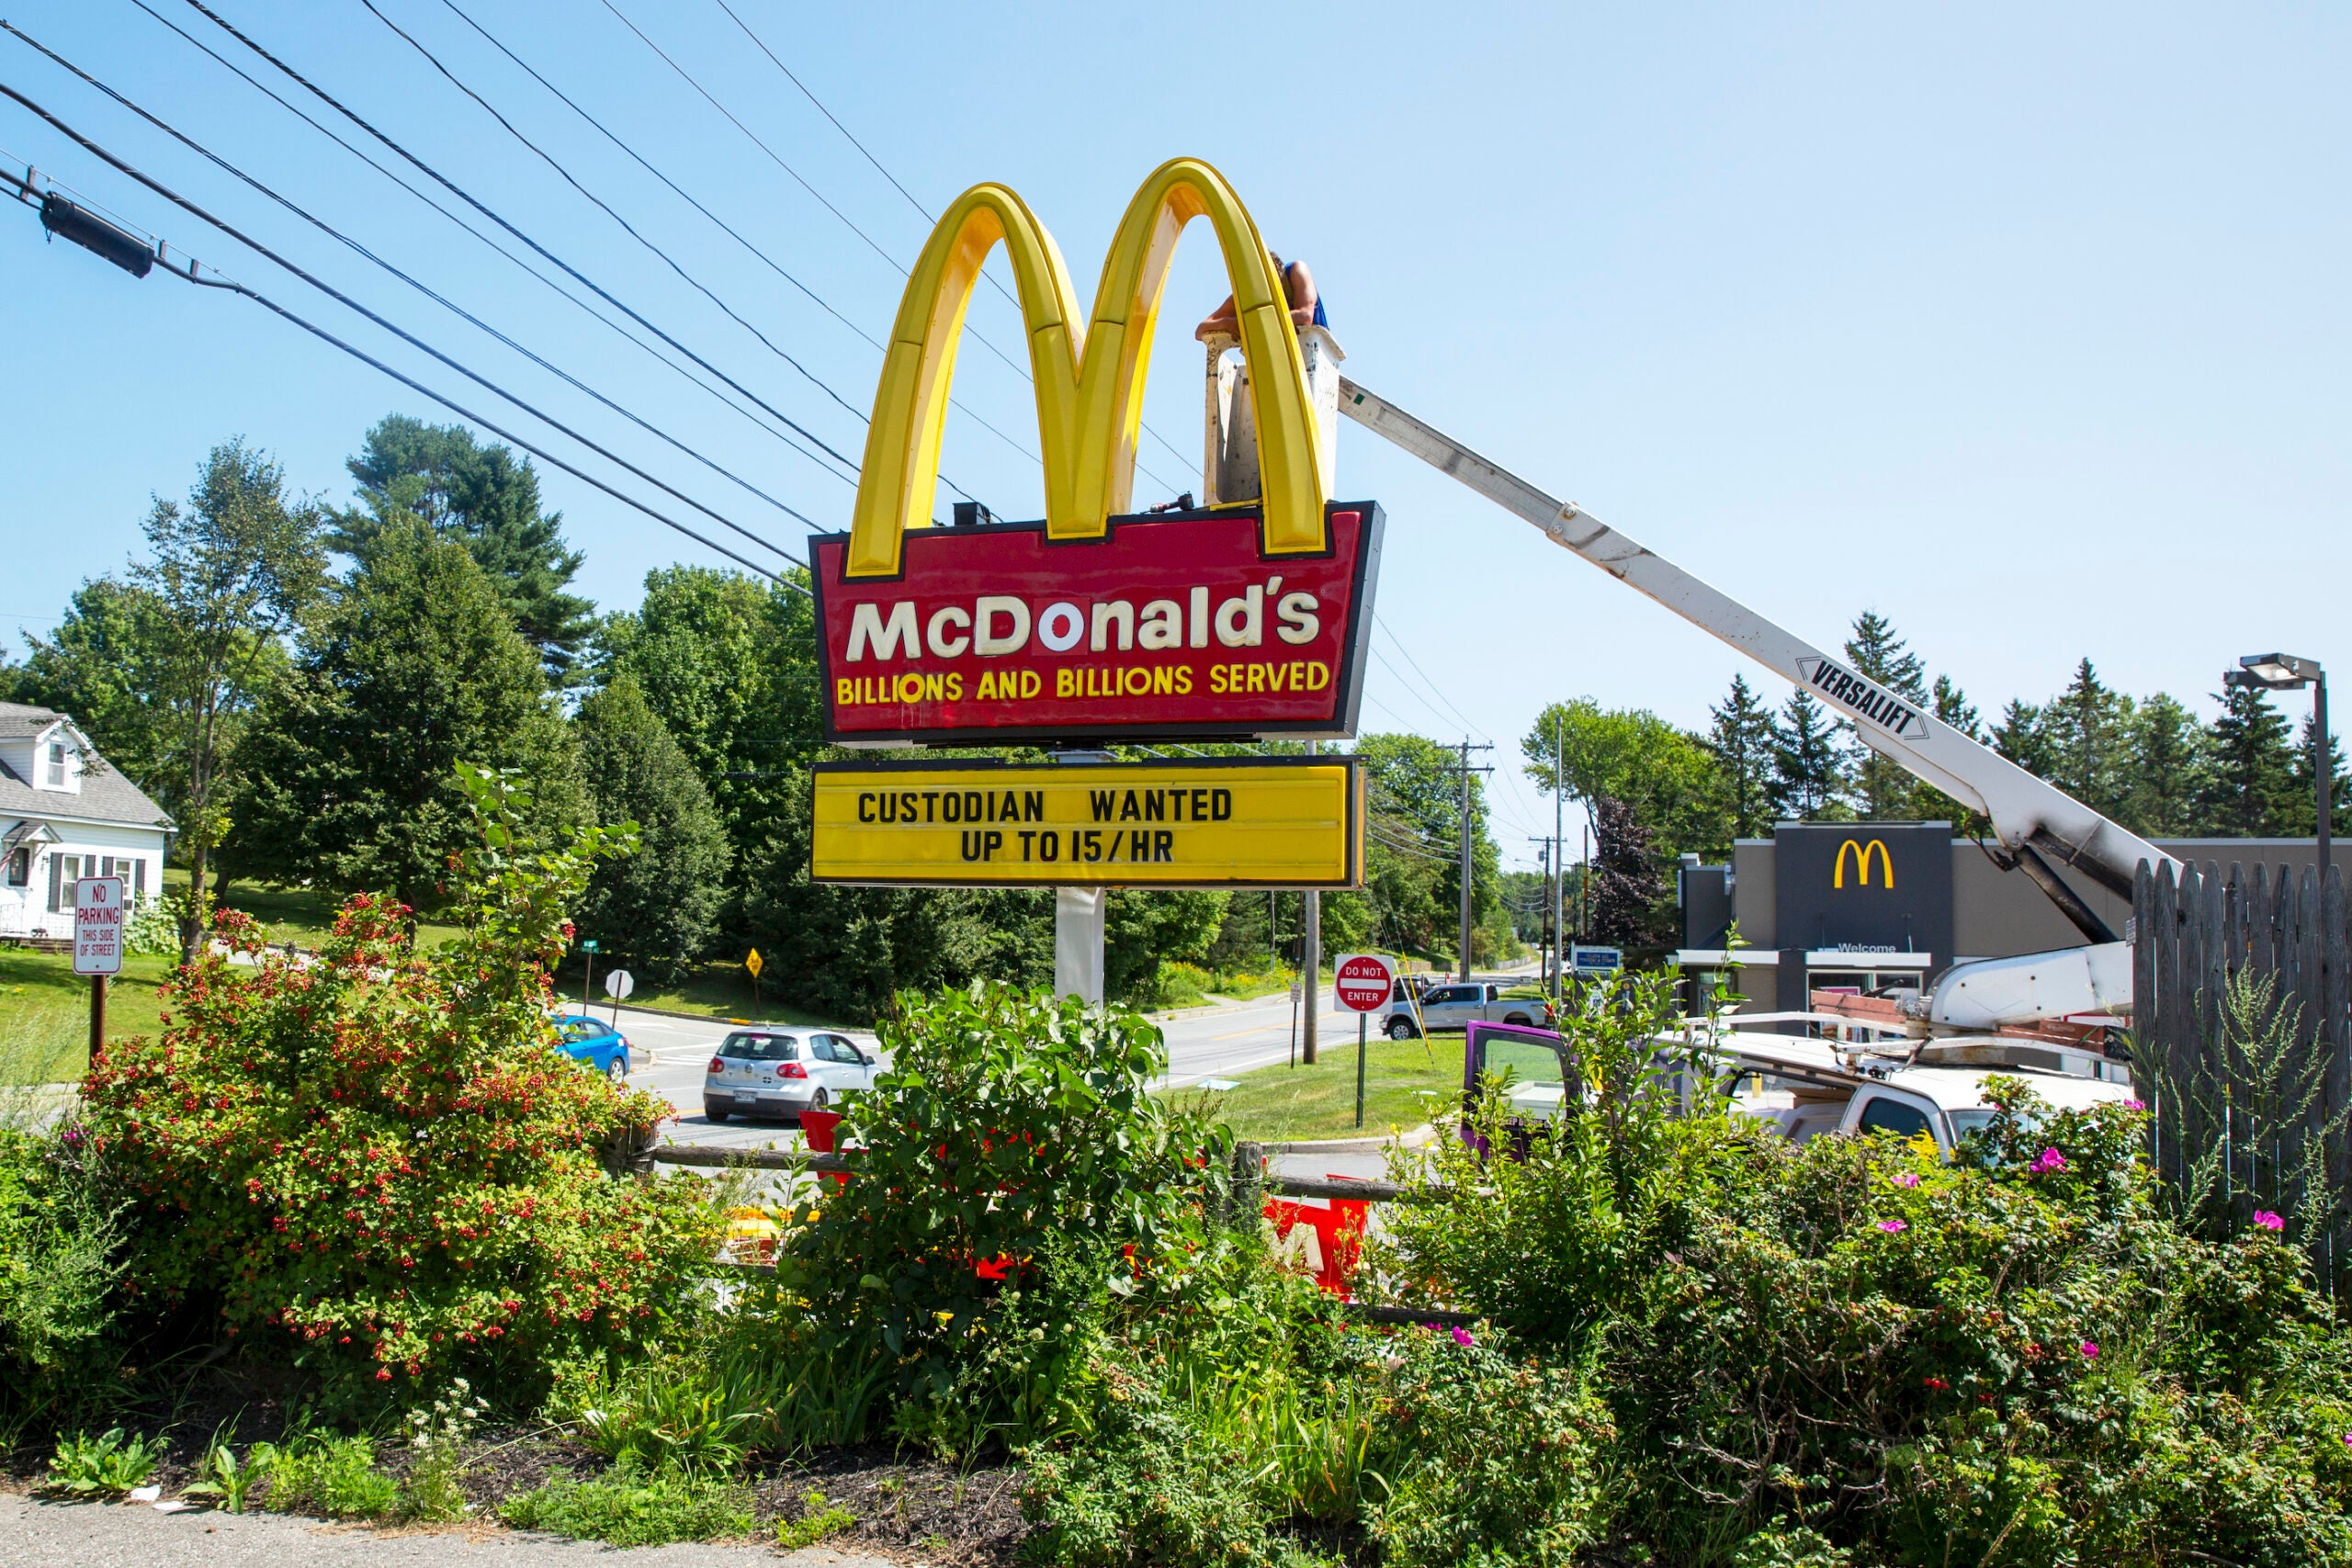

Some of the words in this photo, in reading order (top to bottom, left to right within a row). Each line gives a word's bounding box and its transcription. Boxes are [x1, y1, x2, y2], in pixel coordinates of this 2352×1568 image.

[845, 575, 1320, 662] McDonald's
[837, 672, 963, 705] BILLIONS
[976, 671, 1042, 700] AND
[1057, 665, 1193, 698] BILLIONS
[1210, 661, 1329, 694] SERVED
[1811, 660, 1917, 734] VERSALIFT
[858, 791, 1044, 823] CUSTODIAN
[1090, 789, 1232, 821] WANTED
[961, 830, 1002, 862] UP
[1018, 831, 1059, 862] TO
[1071, 830, 1174, 863] 15/HR
[92, 884, 107, 903] NO
[77, 906, 119, 926] PARKING
[82, 930, 97, 942] THIS
[99, 929, 115, 942] SIDE
[79, 944, 89, 956] OF
[91, 943, 116, 956] STREET
[1838, 942, 1896, 953] Welcome
[1345, 966, 1359, 976] DO
[1362, 967, 1382, 976] NOT
[1347, 991, 1379, 1002] ENTER
